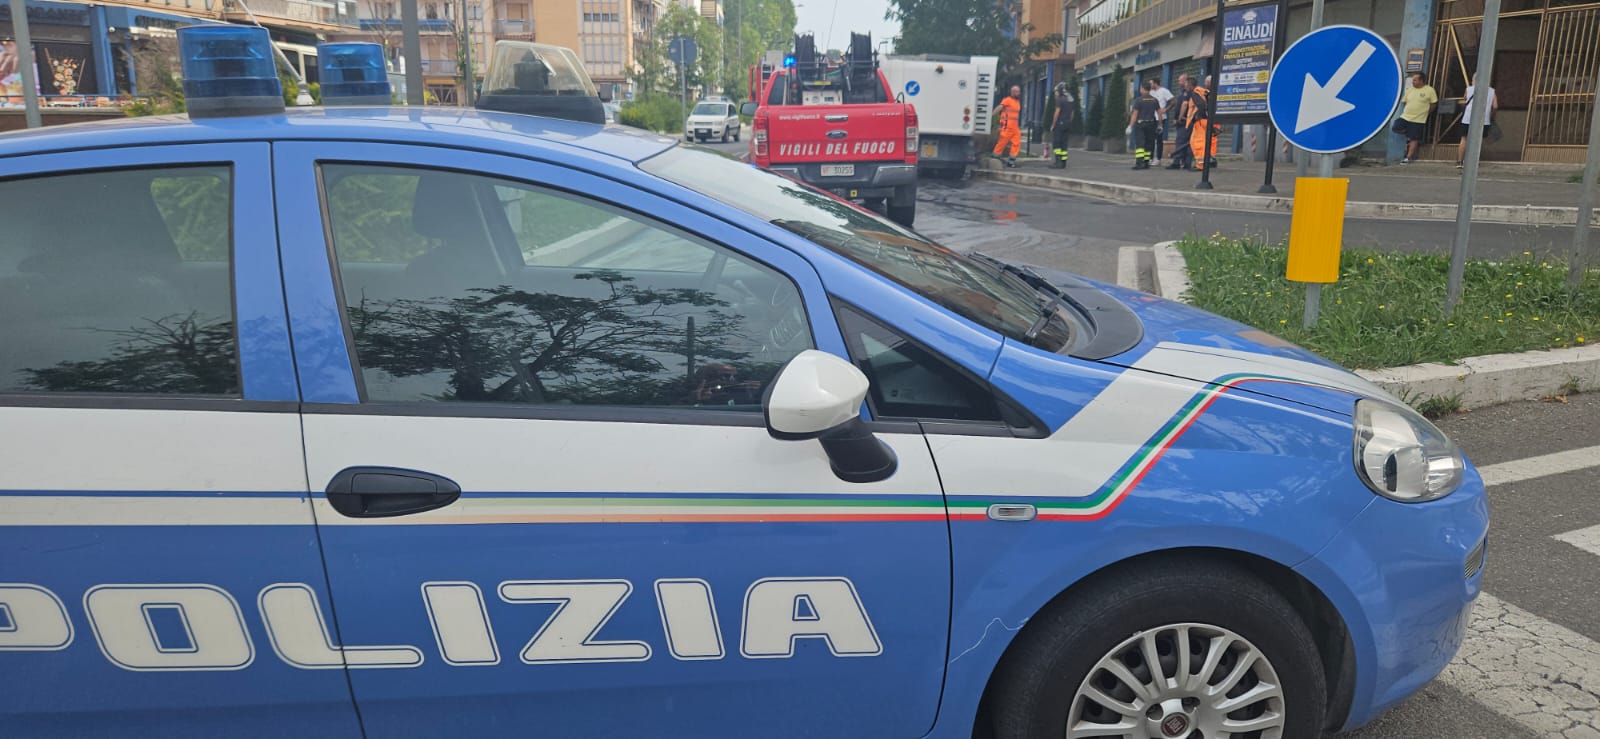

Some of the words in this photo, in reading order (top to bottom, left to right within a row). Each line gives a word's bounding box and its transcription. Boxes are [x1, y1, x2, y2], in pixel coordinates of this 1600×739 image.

[1224, 22, 1273, 41] EINAUDI
[780, 143, 821, 156] VIGILI
[826, 142, 848, 155] DEL
[853, 141, 895, 155] FUOCO
